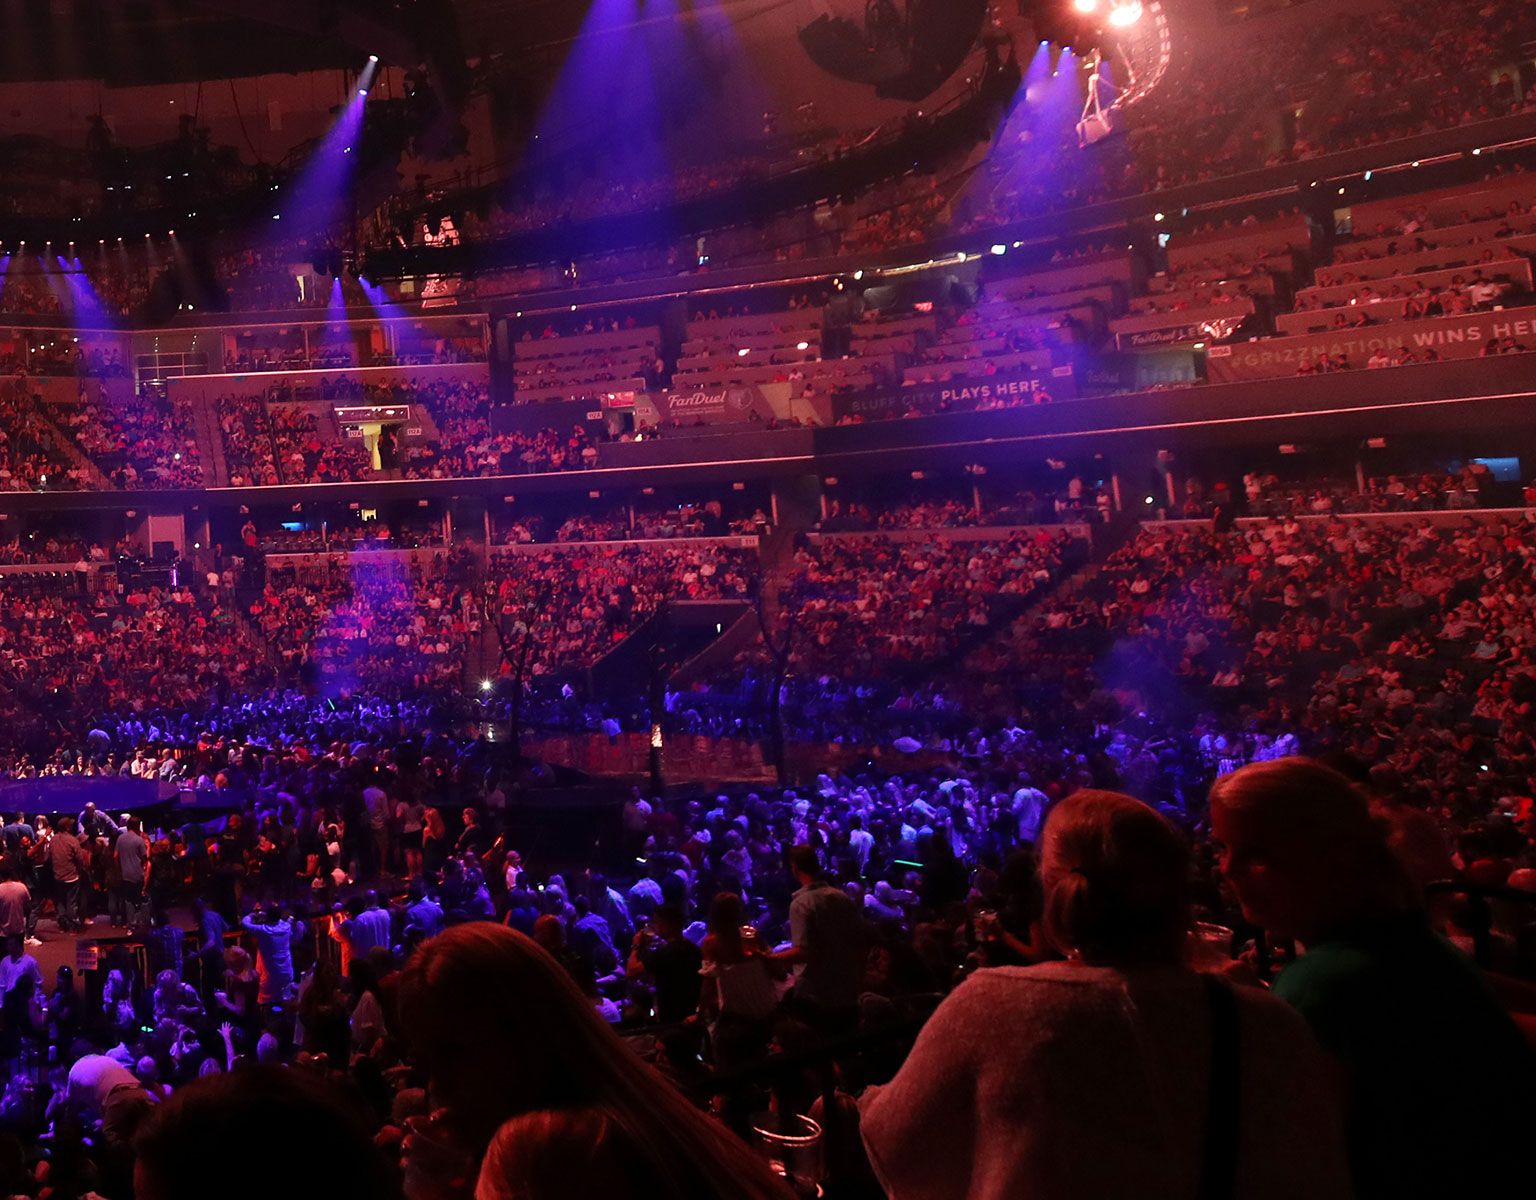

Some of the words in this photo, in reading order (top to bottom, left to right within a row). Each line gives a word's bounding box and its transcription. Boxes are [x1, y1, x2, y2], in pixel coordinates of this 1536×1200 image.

[1413, 326, 1482, 347] WINS
[1492, 319, 1536, 338] HE
[668, 390, 727, 408] FanDuel
[852, 396, 896, 412] BLUFF
[941, 385, 991, 401] PLAYS
